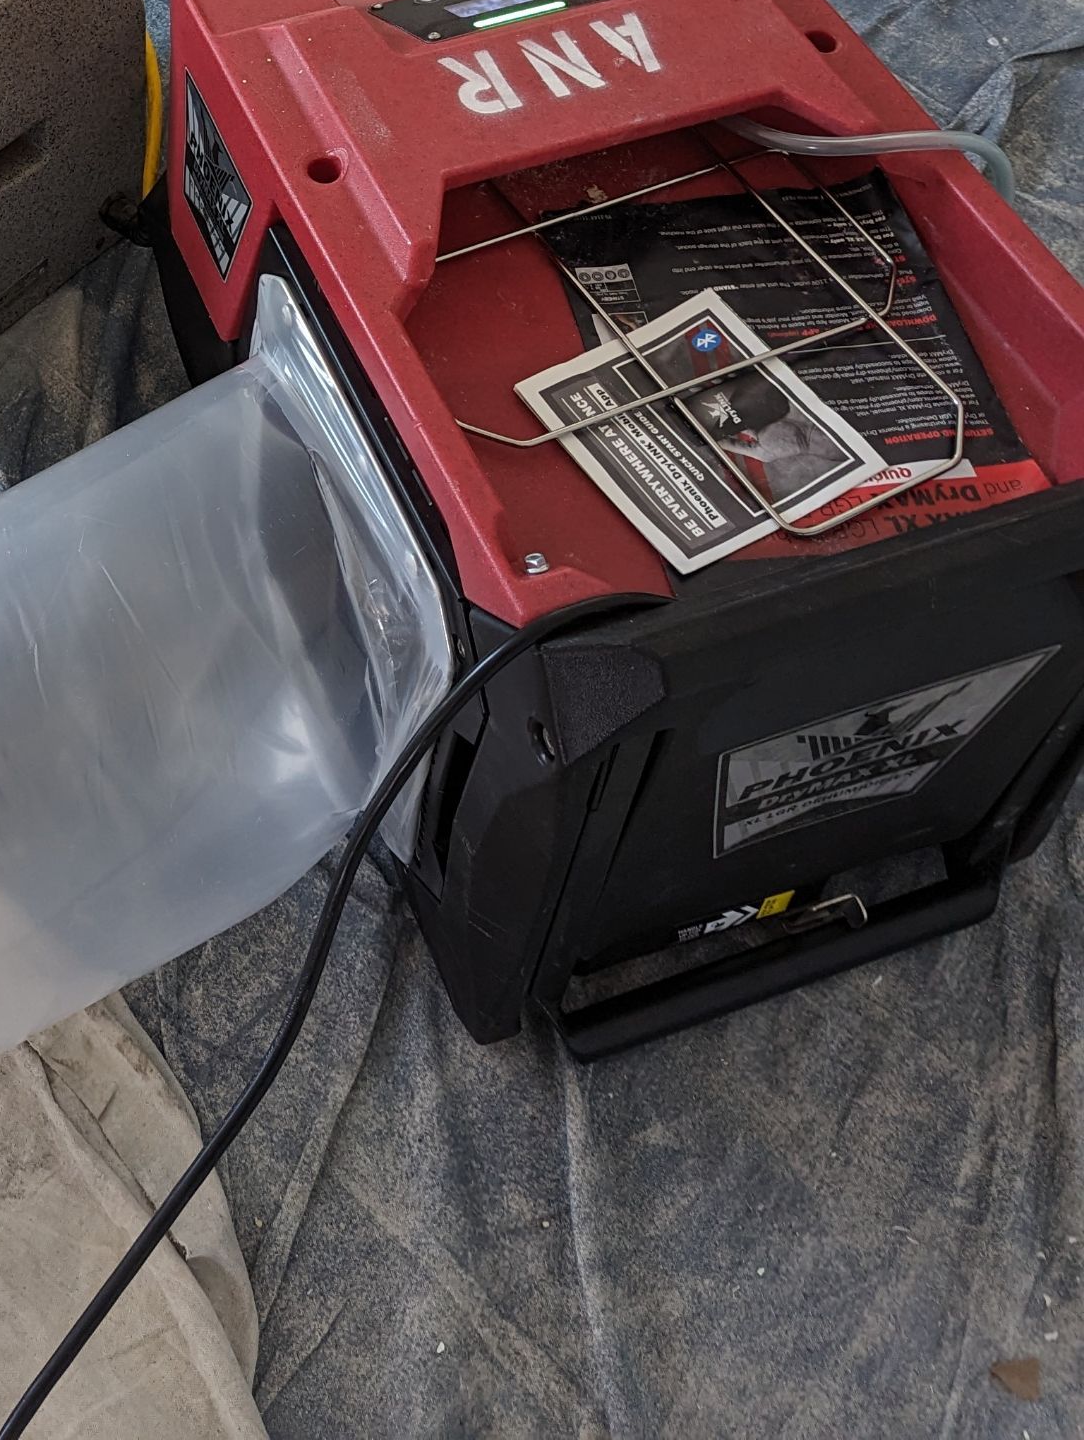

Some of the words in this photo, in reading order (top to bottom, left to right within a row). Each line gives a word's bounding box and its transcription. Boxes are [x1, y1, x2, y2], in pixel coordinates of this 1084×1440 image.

[437, 13, 661, 114] ANR
[594, 387, 614, 407] App
[712, 392, 742, 424] DryLINK
[597, 422, 617, 438] AT
[615, 412, 642, 437] Mobil
[633, 410, 659, 434] GUIDE
[655, 433, 682, 457] START
[882, 429, 943, 444] OPERATION
[610, 437, 690, 520] EVERYWHERE
[678, 456, 706, 481] QUICK
[677, 479, 719, 520] Phoenix
[982, 479, 1022, 497] and
[683, 519, 705, 536] BE
[738, 718, 965, 801] PHOENIX
[756, 764, 874, 810] DryMAX
[882, 751, 916, 772] XL
